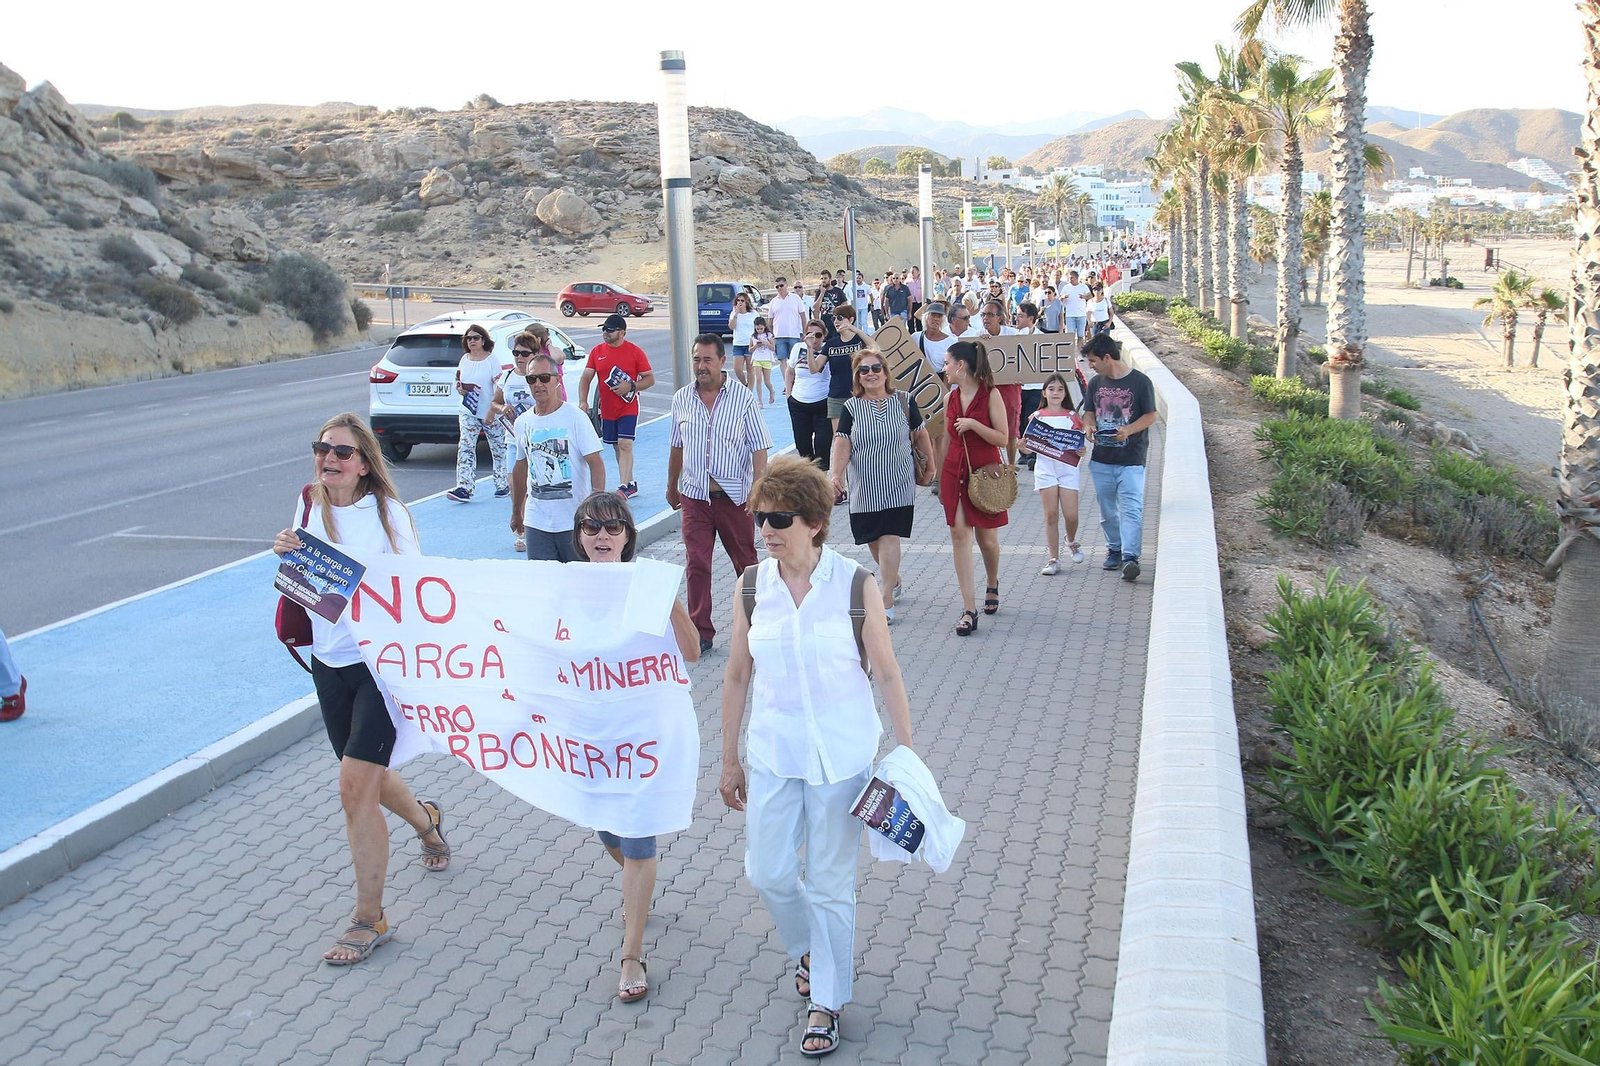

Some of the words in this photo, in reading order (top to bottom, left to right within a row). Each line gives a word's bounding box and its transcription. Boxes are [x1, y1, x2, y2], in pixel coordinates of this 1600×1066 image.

[874, 325, 915, 371] OH
[412, 385, 431, 394] 3328
[434, 385, 449, 394] JMV
[286, 559, 296, 570] en
[296, 564, 339, 593] Carboneras
[313, 548, 321, 558] la
[321, 554, 341, 571] carga
[342, 565, 354, 577] de
[315, 562, 326, 574] de
[326, 568, 349, 587] hierro
[351, 576, 456, 624] NO
[494, 619, 510, 633] a
[555, 618, 571, 641] la
[358, 640, 506, 678] ARGA
[400, 704, 476, 733] ERRO
[532, 714, 546, 723] en
[447, 732, 660, 778] RBONERAS
[886, 806, 897, 819] en
[898, 838, 909, 847] la
